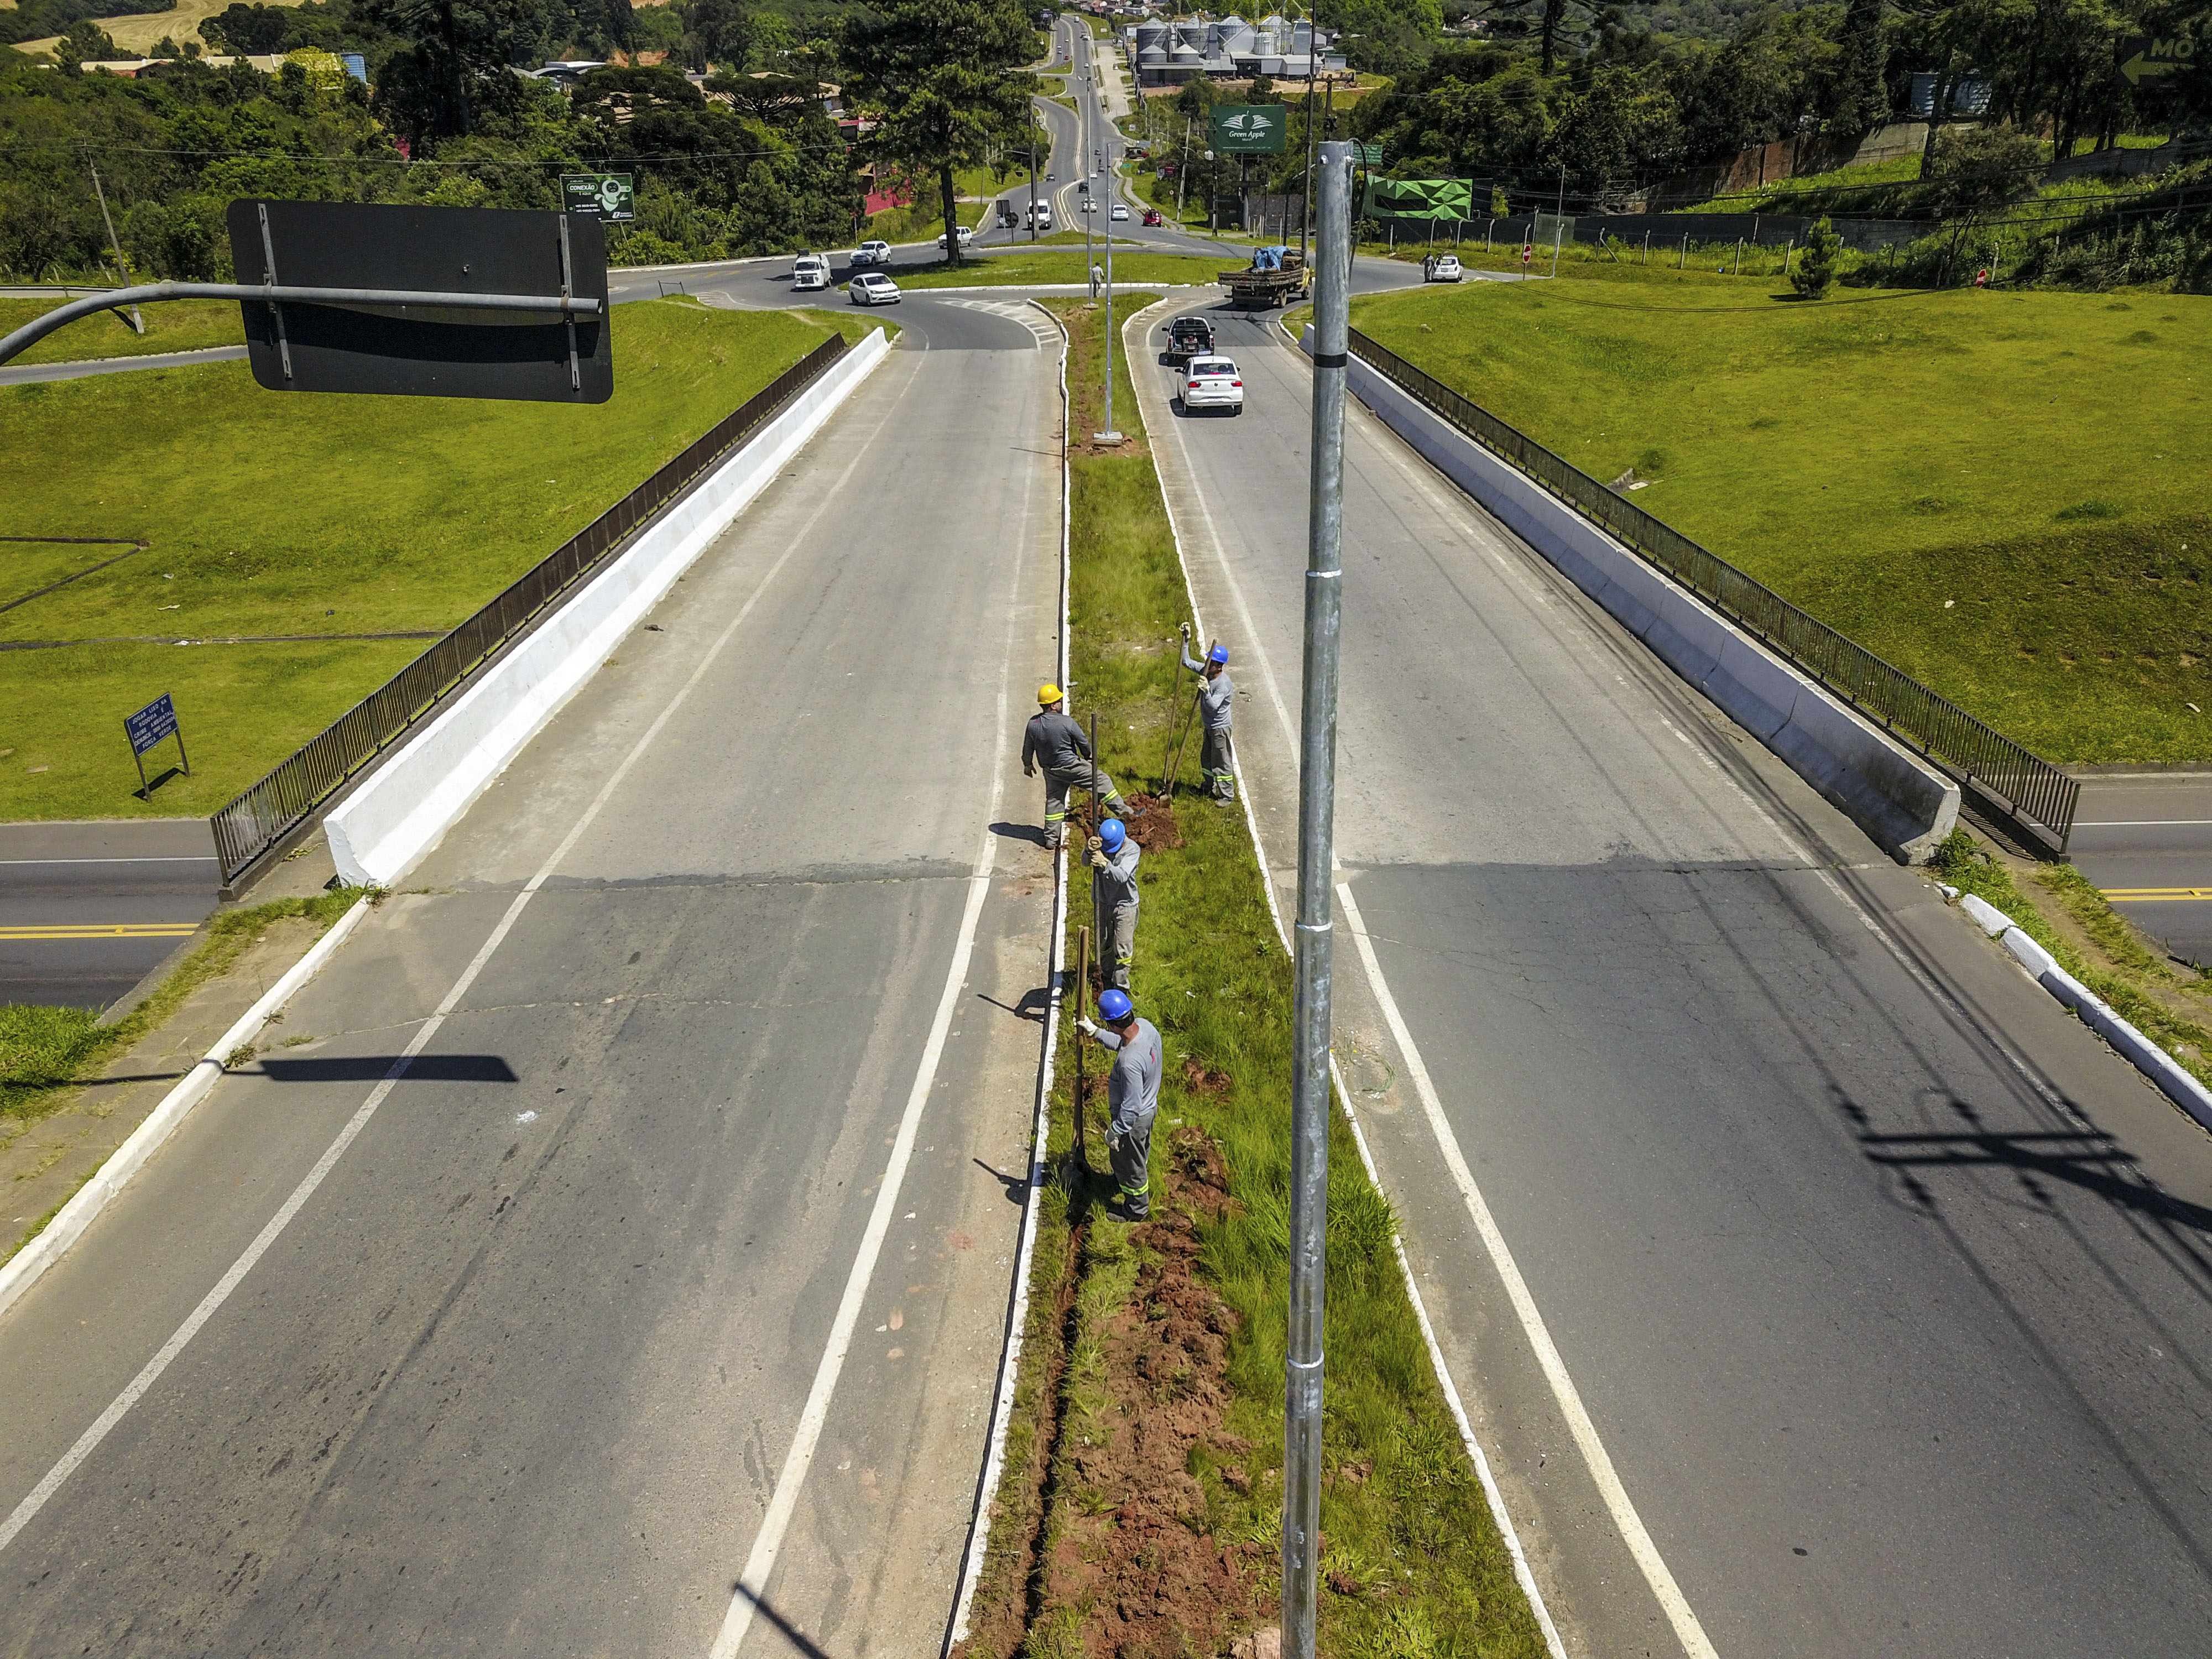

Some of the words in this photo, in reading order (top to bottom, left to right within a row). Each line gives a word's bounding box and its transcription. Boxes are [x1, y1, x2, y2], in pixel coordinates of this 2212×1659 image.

[1248, 131, 1265, 139] Apple
[133, 712, 146, 724] JOGAR
[149, 704, 159, 713] LIXO
[139, 713, 157, 728] RODOVIA
[134, 727, 147, 739] CRIME
[151, 710, 173, 728] AMBIENTAL
[159, 725, 171, 737] VERDE
